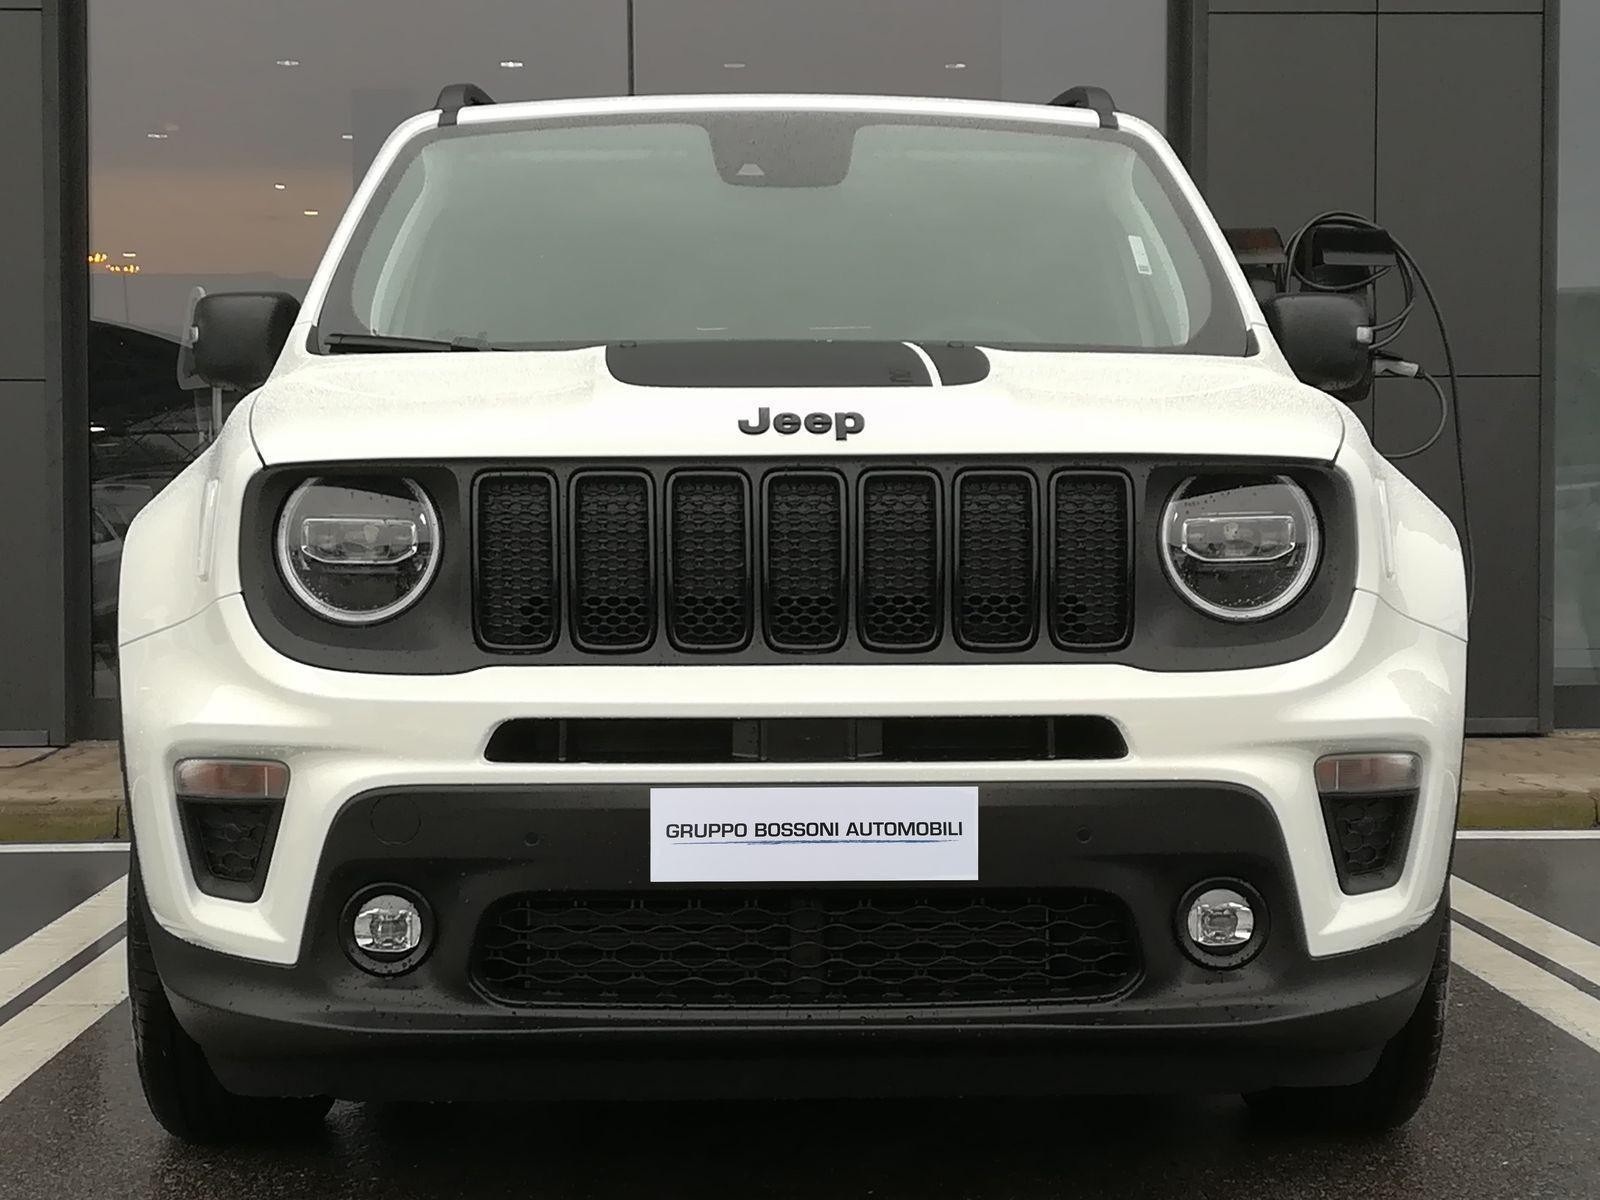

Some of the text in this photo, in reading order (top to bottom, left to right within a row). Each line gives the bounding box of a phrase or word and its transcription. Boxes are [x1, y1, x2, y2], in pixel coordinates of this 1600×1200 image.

[738, 407, 865, 441] Jeep
[665, 821, 963, 838] GRUPPO BOSSONI AUTOMOBILI
